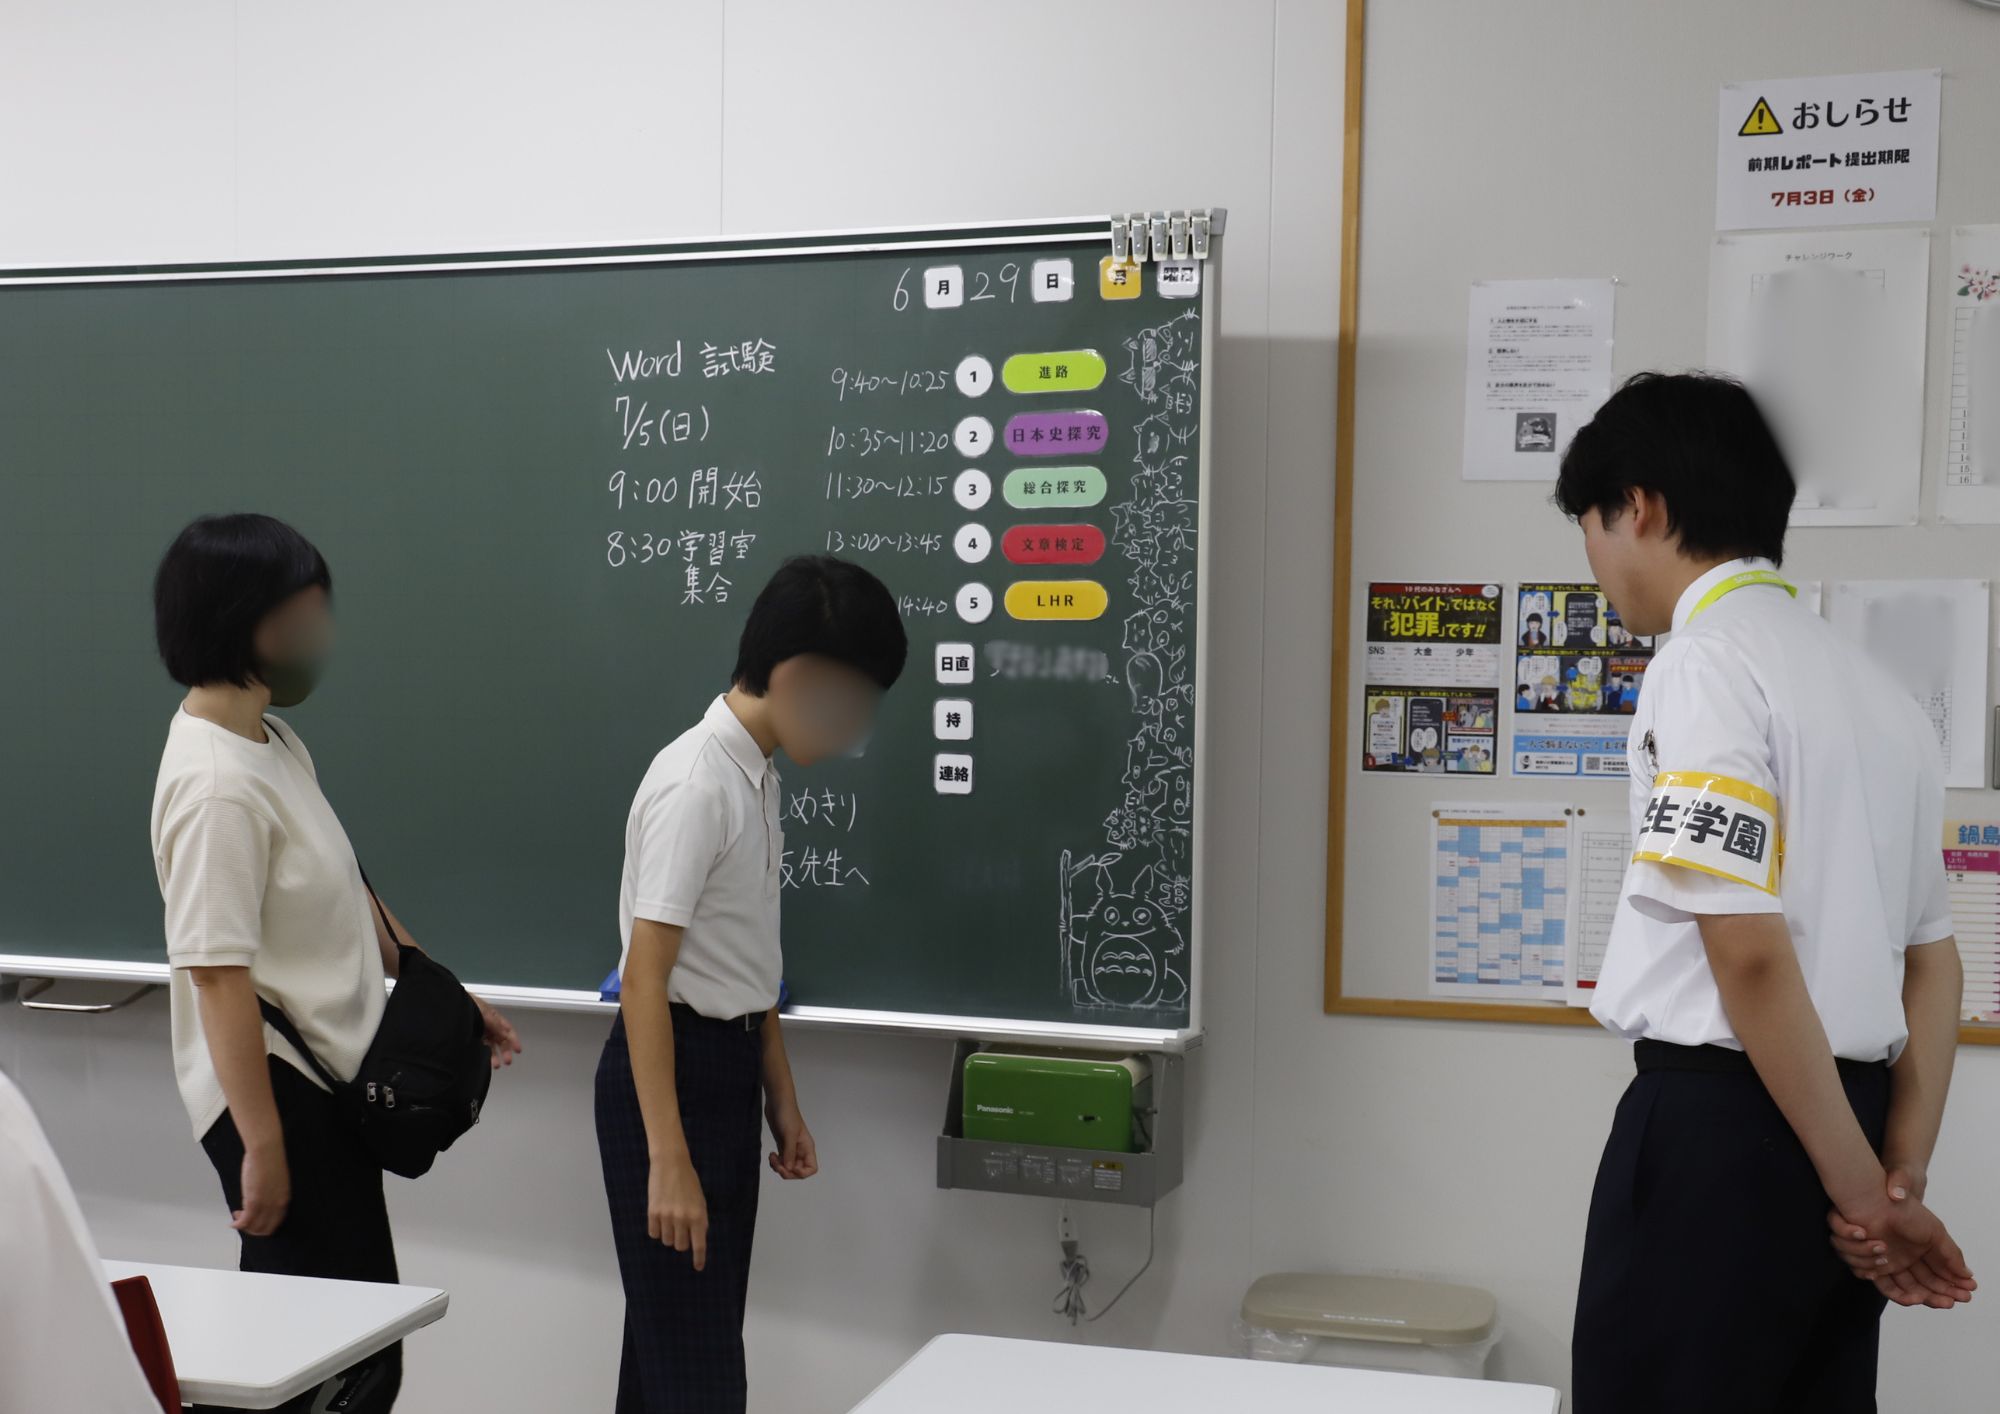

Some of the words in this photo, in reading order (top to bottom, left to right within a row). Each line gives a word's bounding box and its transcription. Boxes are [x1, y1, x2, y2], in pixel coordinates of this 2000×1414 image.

[1792, 97, 1912, 130] おしらせ
[1748, 148, 1910, 173] 前期レポート提出期限
[1785, 251, 1853, 262] チャレンジワーク
[893, 267, 911, 312] 6
[937, 279, 951, 297] 月
[969, 262, 1020, 304] 29
[1046, 273, 1060, 290] 日
[606, 339, 682, 383] Word
[699, 337, 777, 379] 試験
[969, 369, 978, 384] 1
[1038, 364, 1069, 380] 進路
[968, 429, 979, 444] 2
[1012, 424, 1102, 443] 日本史探究
[968, 482, 978, 497] 3
[1022, 479, 1087, 496] 総合探究
[967, 536, 979, 551] 4
[1022, 536, 1085, 553] 文章検定
[680, 564, 733, 605] 集合
[969, 596, 979, 611] 5
[1036, 594, 1075, 608] LHR
[1368, 646, 1386, 656] SNS
[1414, 647, 1433, 657] 大金
[1456, 647, 1475, 657] 少年
[941, 655, 970, 672] 日直
[946, 712, 962, 728] 持
[939, 765, 969, 783] 連絡
[1639, 795, 1767, 864] 生学園
[1958, 824, 2000, 846] 鍋島
[976, 1104, 1014, 1114] Panasonic
